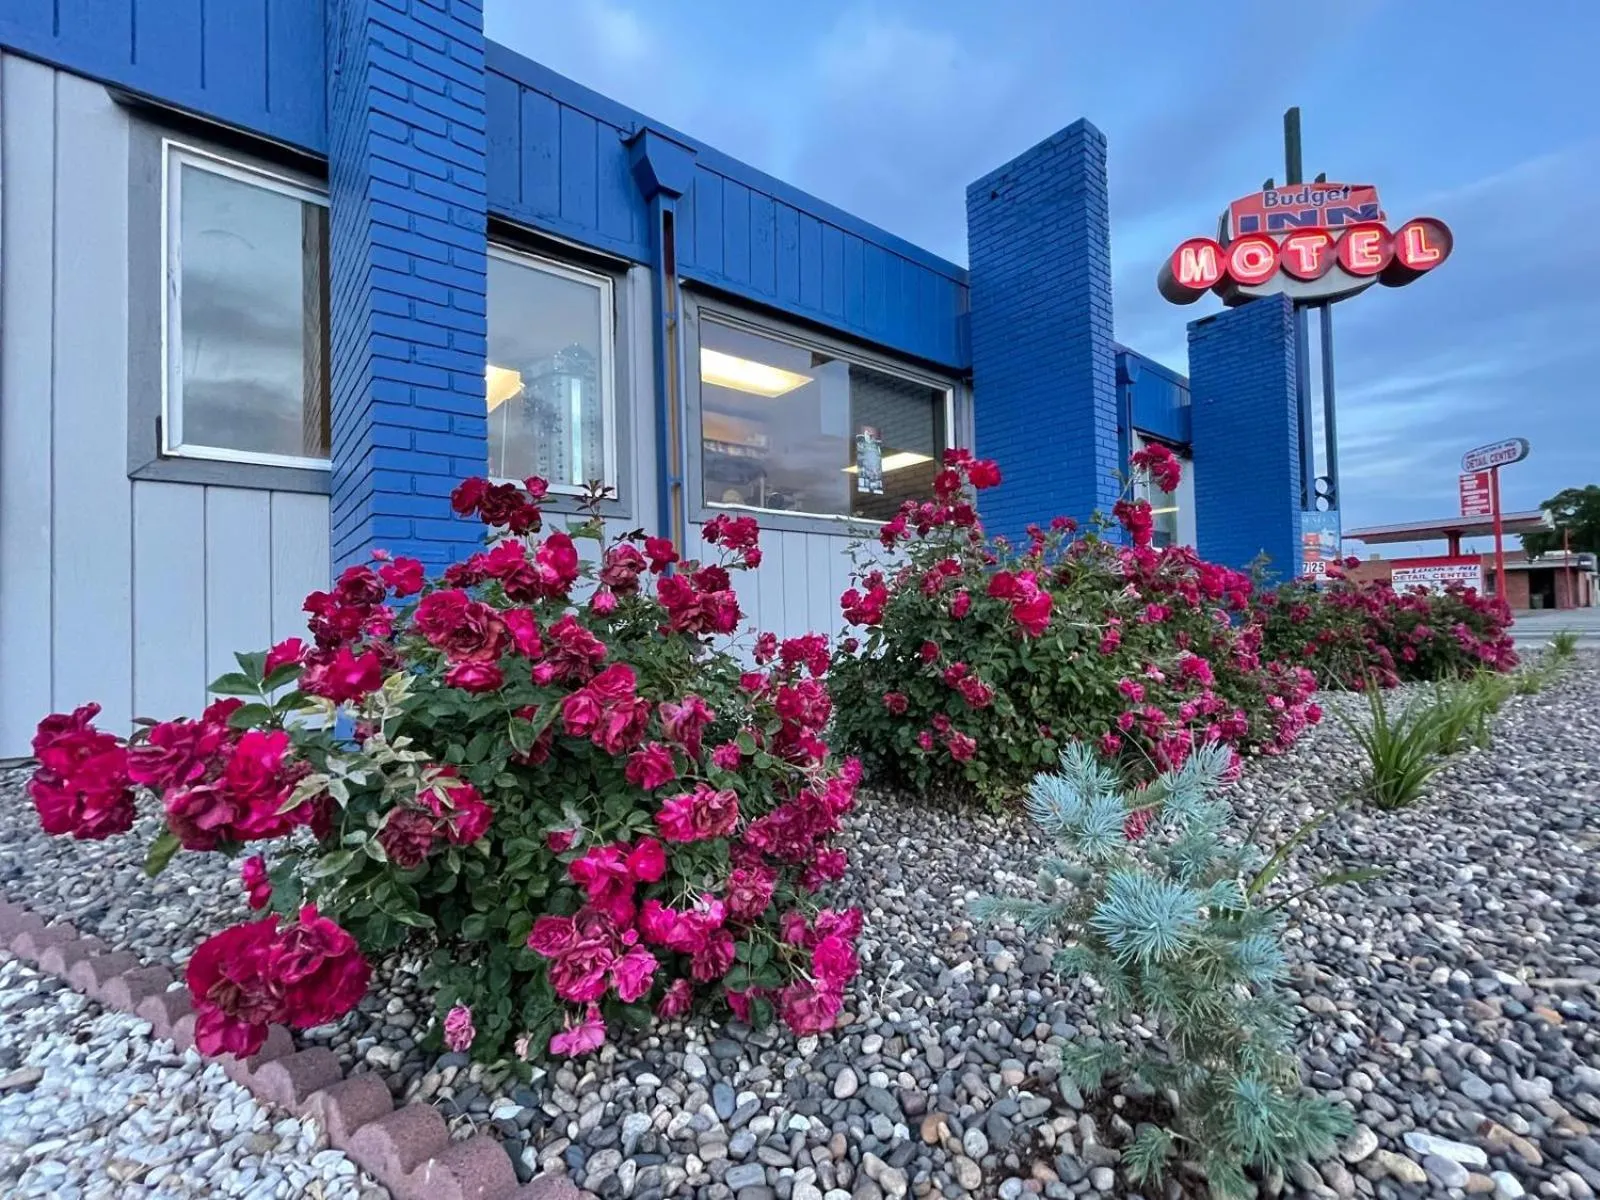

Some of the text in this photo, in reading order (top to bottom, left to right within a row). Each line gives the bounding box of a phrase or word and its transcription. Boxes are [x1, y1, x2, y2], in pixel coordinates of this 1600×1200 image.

[1263, 185, 1350, 208] Budget
[1238, 203, 1380, 233] INN
[1179, 225, 1440, 283] MOTEL
